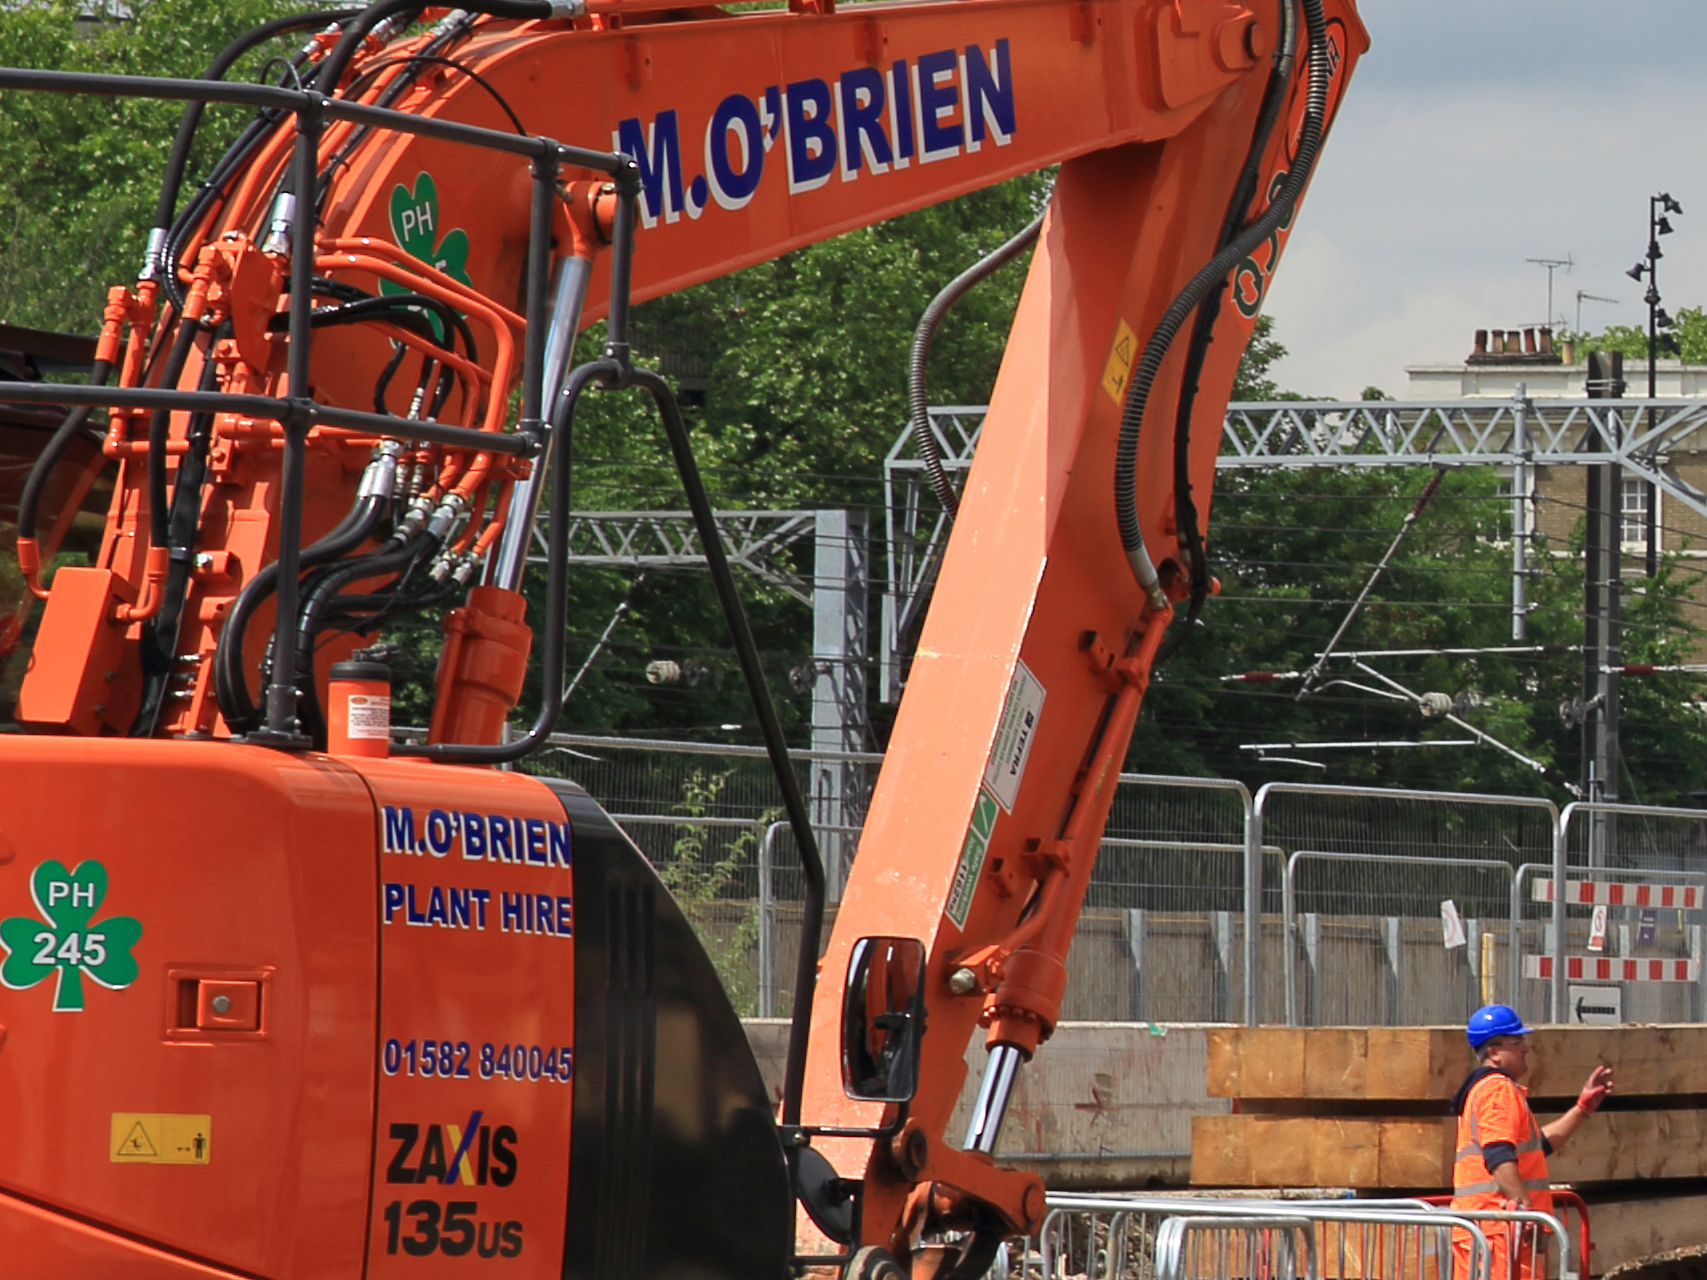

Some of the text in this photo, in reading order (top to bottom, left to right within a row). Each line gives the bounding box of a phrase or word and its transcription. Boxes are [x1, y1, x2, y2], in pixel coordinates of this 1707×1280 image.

[612, 37, 1016, 229] M.O'BRIEN
[401, 201, 434, 242] PH
[1010, 728, 1030, 776] TEFRA
[381, 805, 571, 869] M.O'BRIEN
[48, 881, 95, 908] PH
[382, 882, 572, 938] PLANT HIRE
[32, 931, 106, 966] 245
[383, 1038, 572, 1084] 01582 840045
[386, 1110, 518, 1188] ZAXIS
